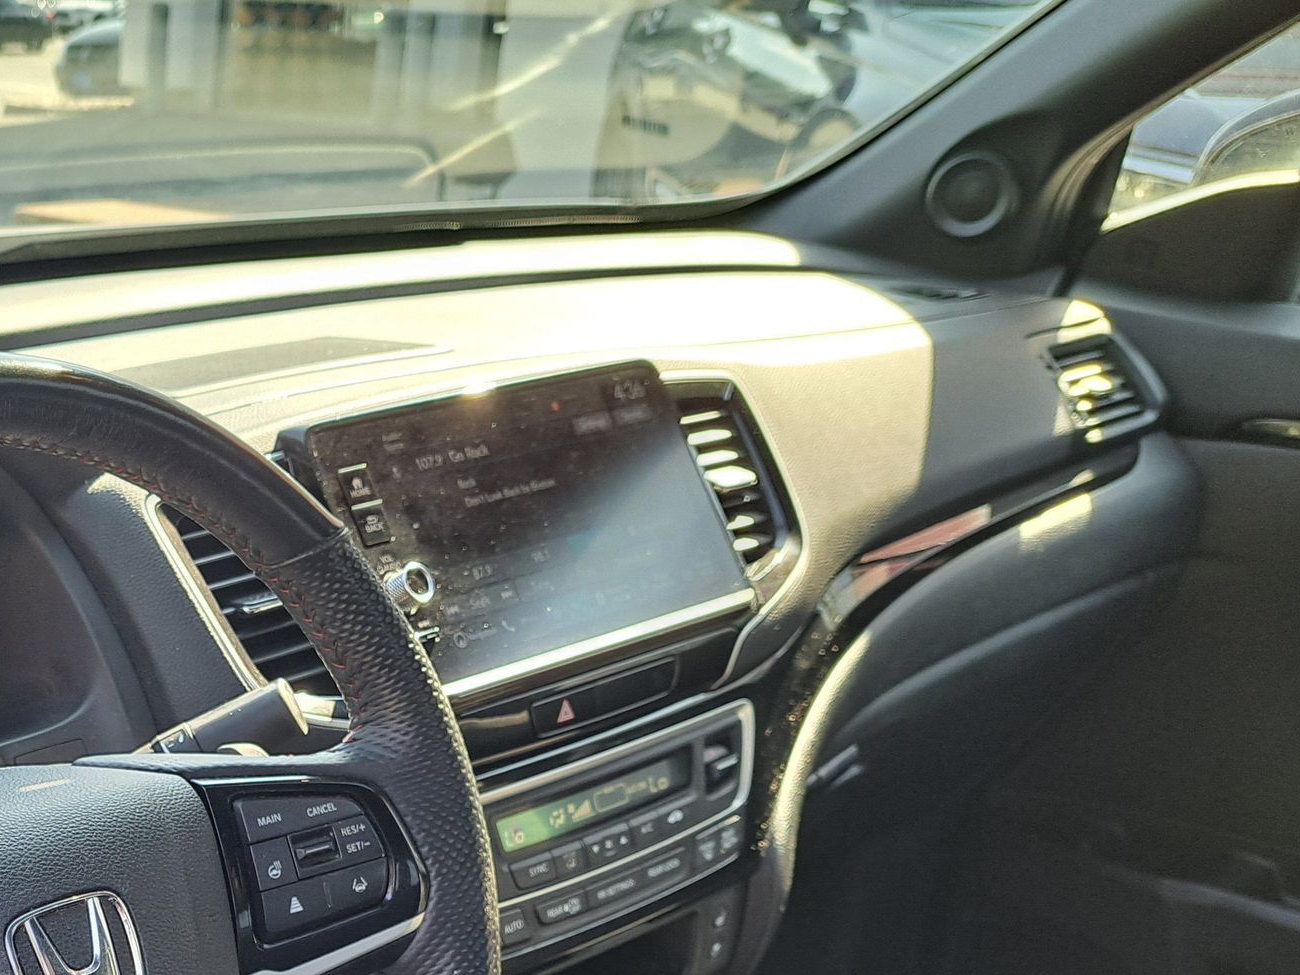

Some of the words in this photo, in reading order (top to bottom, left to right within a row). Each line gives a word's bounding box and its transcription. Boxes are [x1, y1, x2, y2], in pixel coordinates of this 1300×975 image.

[306, 802, 337, 818] CANCEL
[257, 813, 282, 827] MAIN
[529, 863, 550, 877] SYNC
[504, 918, 525, 933] AUTO
